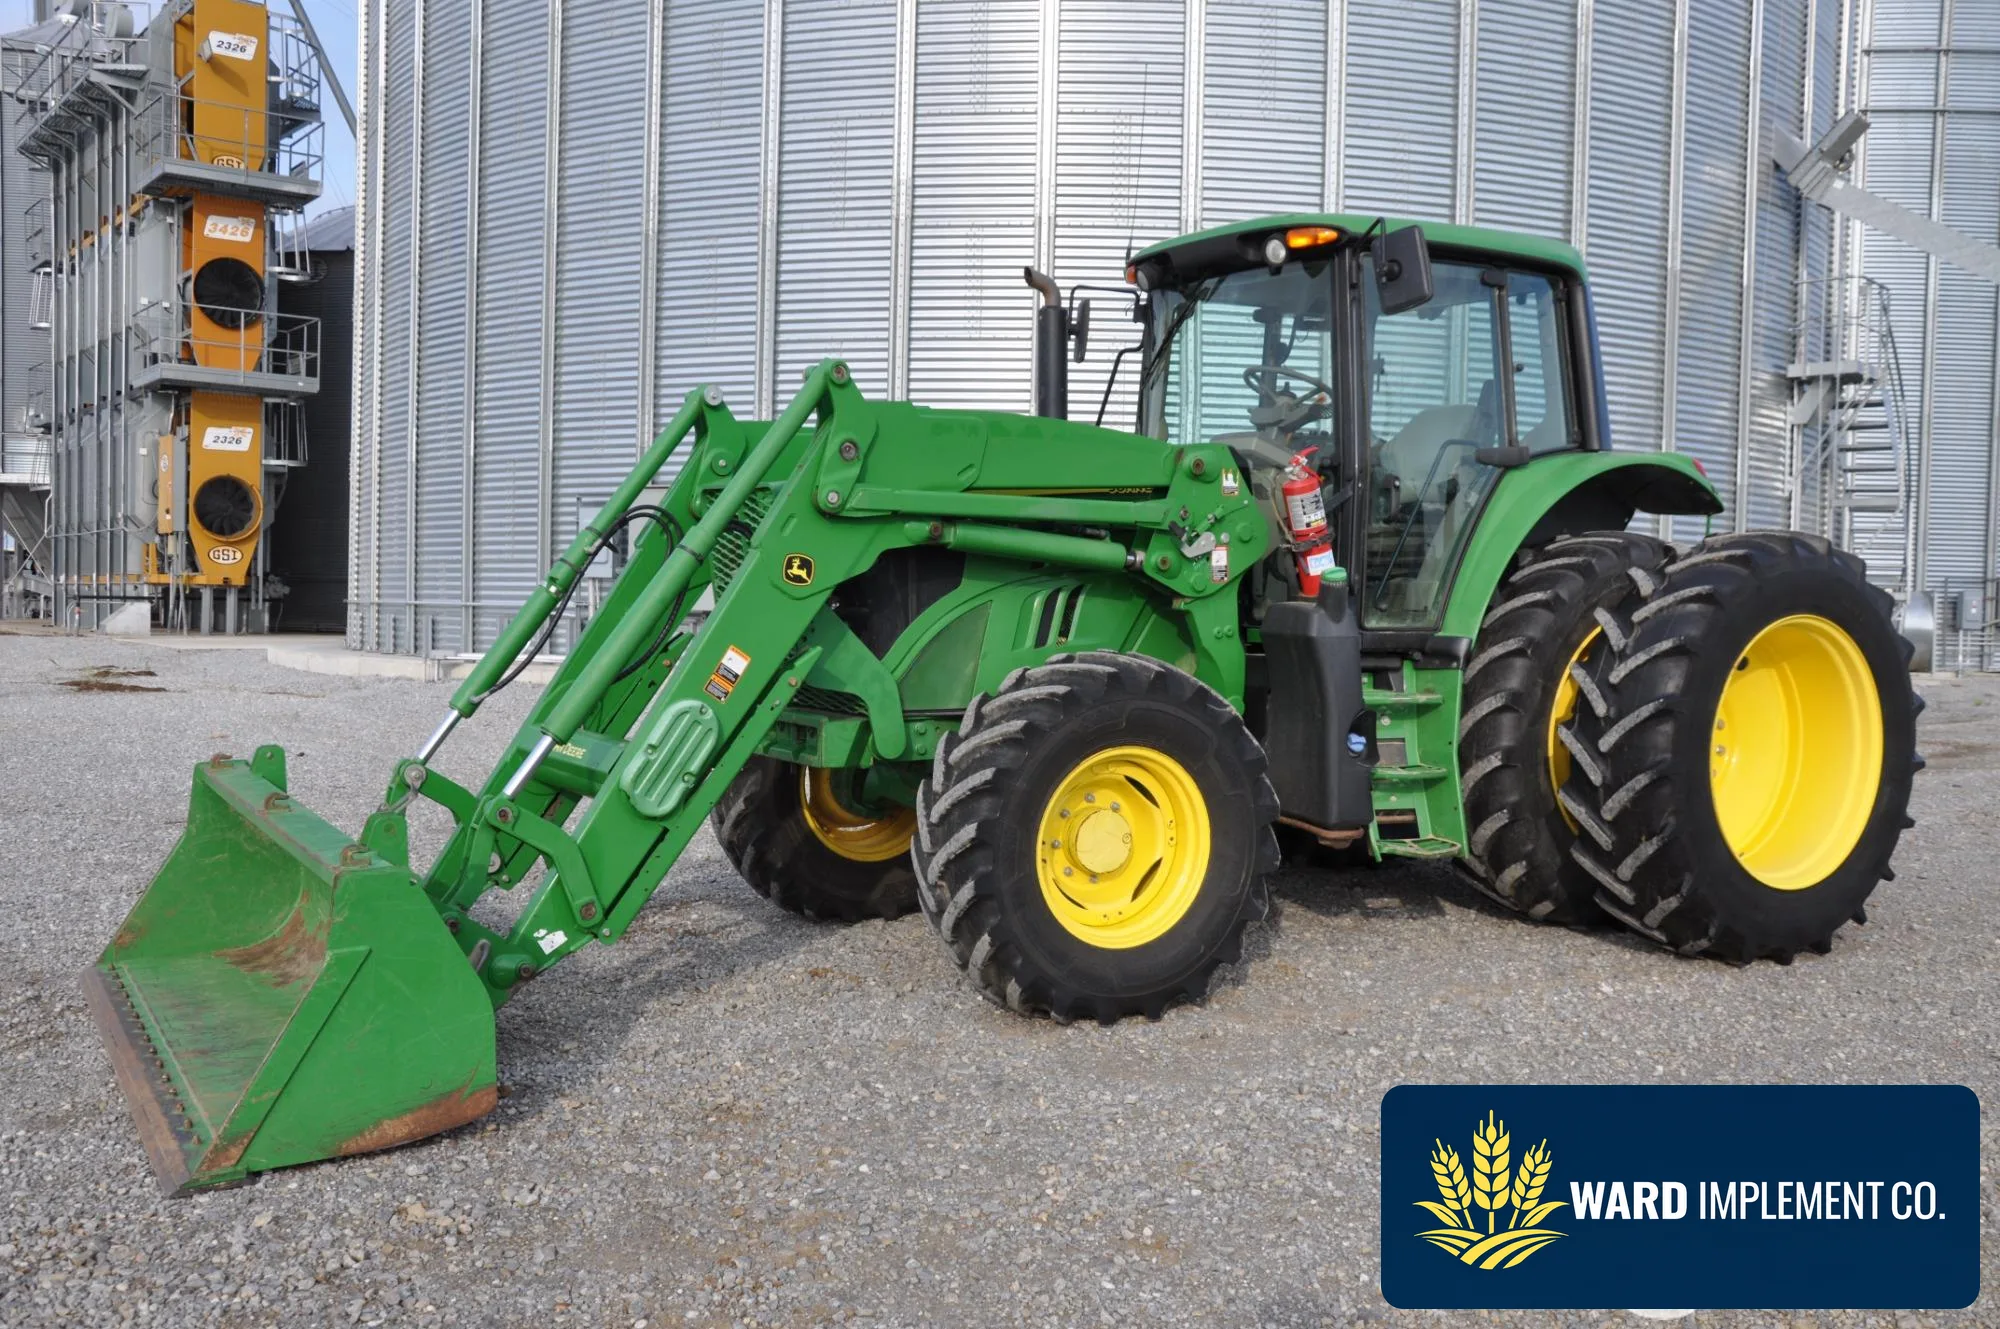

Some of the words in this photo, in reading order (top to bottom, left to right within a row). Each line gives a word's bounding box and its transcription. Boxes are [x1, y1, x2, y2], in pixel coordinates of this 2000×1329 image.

[216, 40, 247, 53] 2326
[208, 222, 250, 238] 3426
[212, 435, 243, 445] 2326
[212, 549, 238, 561] GSI
